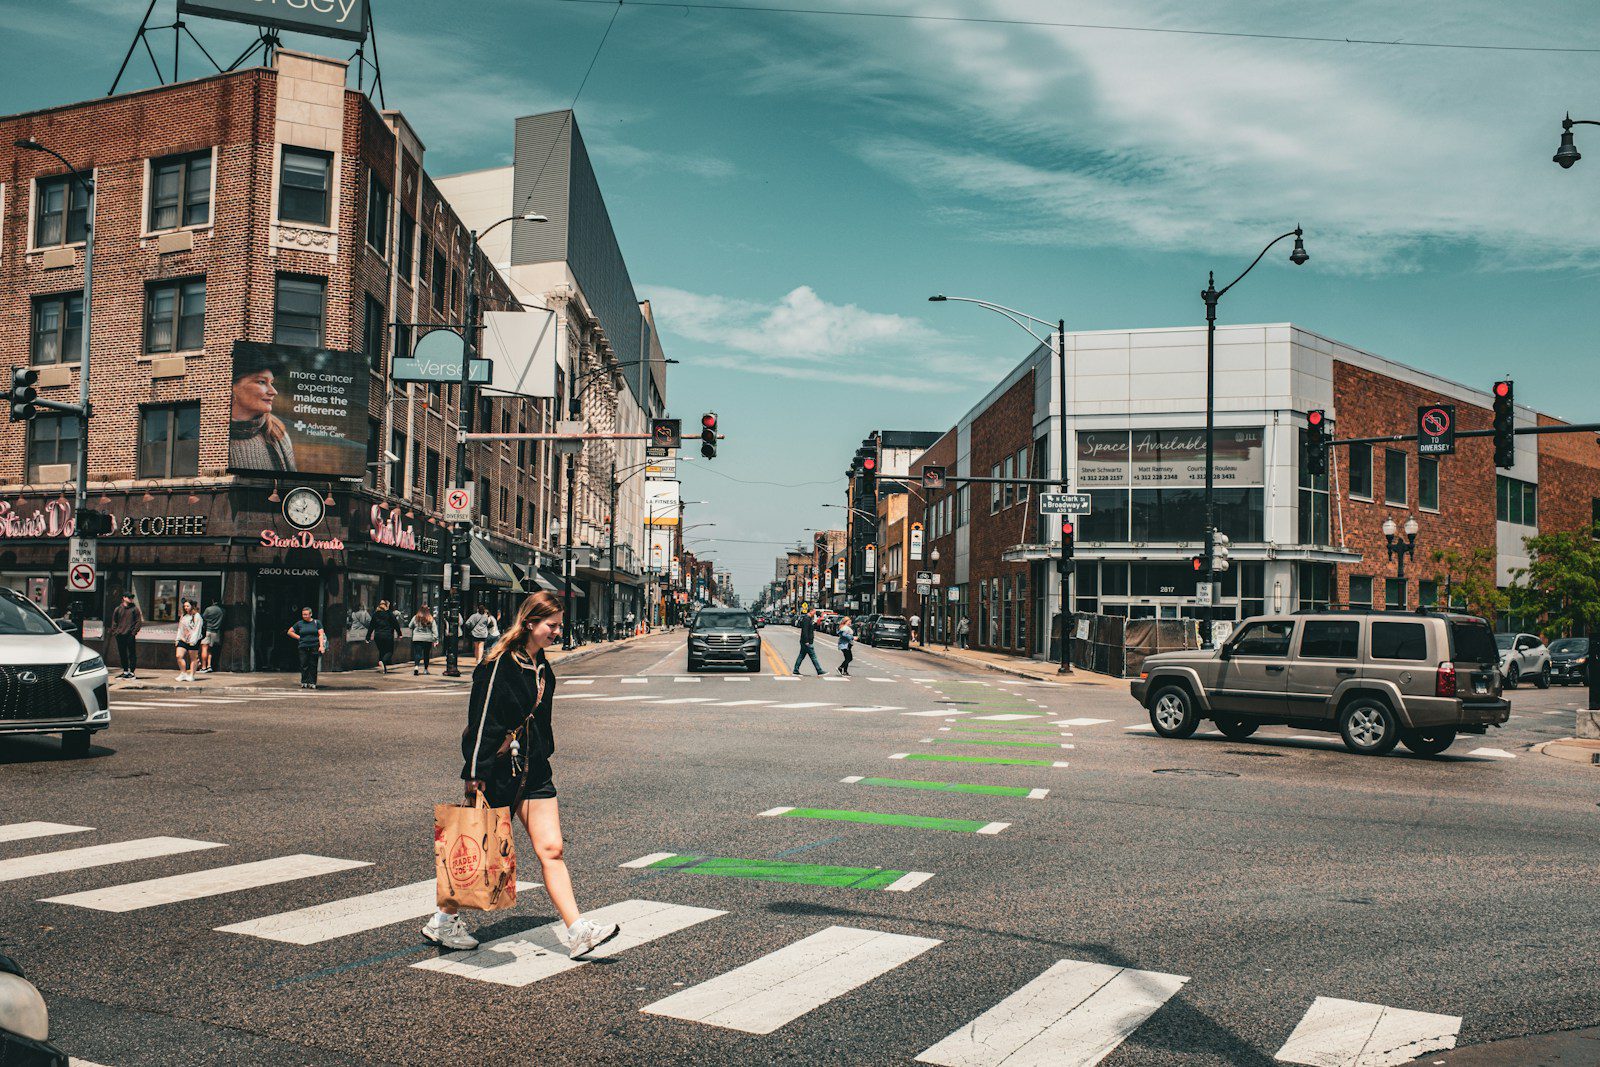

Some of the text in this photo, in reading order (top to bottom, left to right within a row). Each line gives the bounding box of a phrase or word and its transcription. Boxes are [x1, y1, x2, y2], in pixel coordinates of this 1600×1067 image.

[289, 371, 353, 383] more cancer
[297, 383, 345, 394] expertise
[293, 394, 348, 405] makes the
[293, 404, 347, 416] difference
[307, 423, 338, 431] Advocate
[306, 429, 328, 437] Health
[1083, 434, 1207, 456] Space Available
[1047, 501, 1081, 510] Broadway
[121, 516, 133, 536] &
[139, 515, 204, 536] COFFEE
[260, 529, 345, 550] Stan's Donuts
[291, 568, 320, 576] CLARK
[452, 855, 478, 869] TRADER
[454, 865, 474, 876] JOE'S
